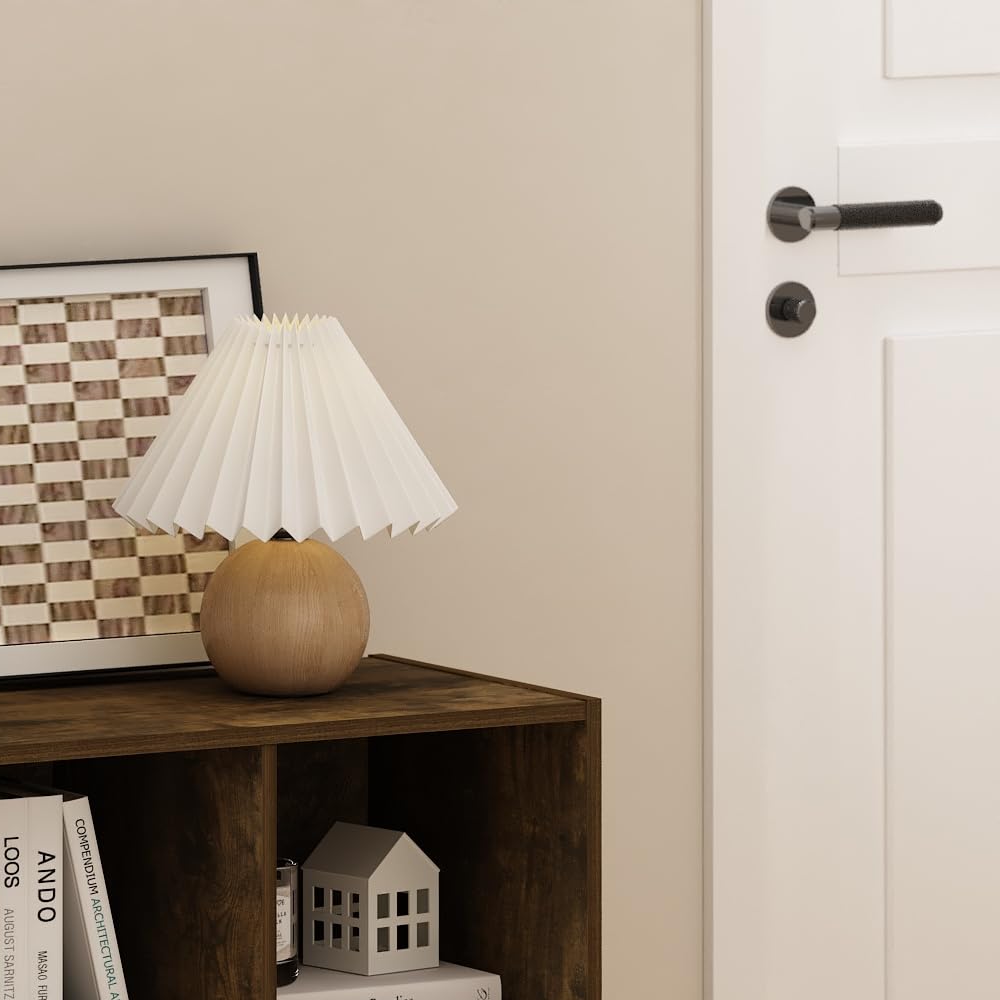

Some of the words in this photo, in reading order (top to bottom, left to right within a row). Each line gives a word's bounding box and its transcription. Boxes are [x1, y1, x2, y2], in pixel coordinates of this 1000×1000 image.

[4, 836, 20, 888] LOOS
[37, 850, 56, 922] ANDO
[75, 819, 98, 895] COMPENDIUM
[91, 898, 117, 990] ARCHITECTURAL
[3, 908, 15, 951] AUGUST
[3, 954, 15, 1000] SARNITZ
[37, 950, 48, 981] MASAO
